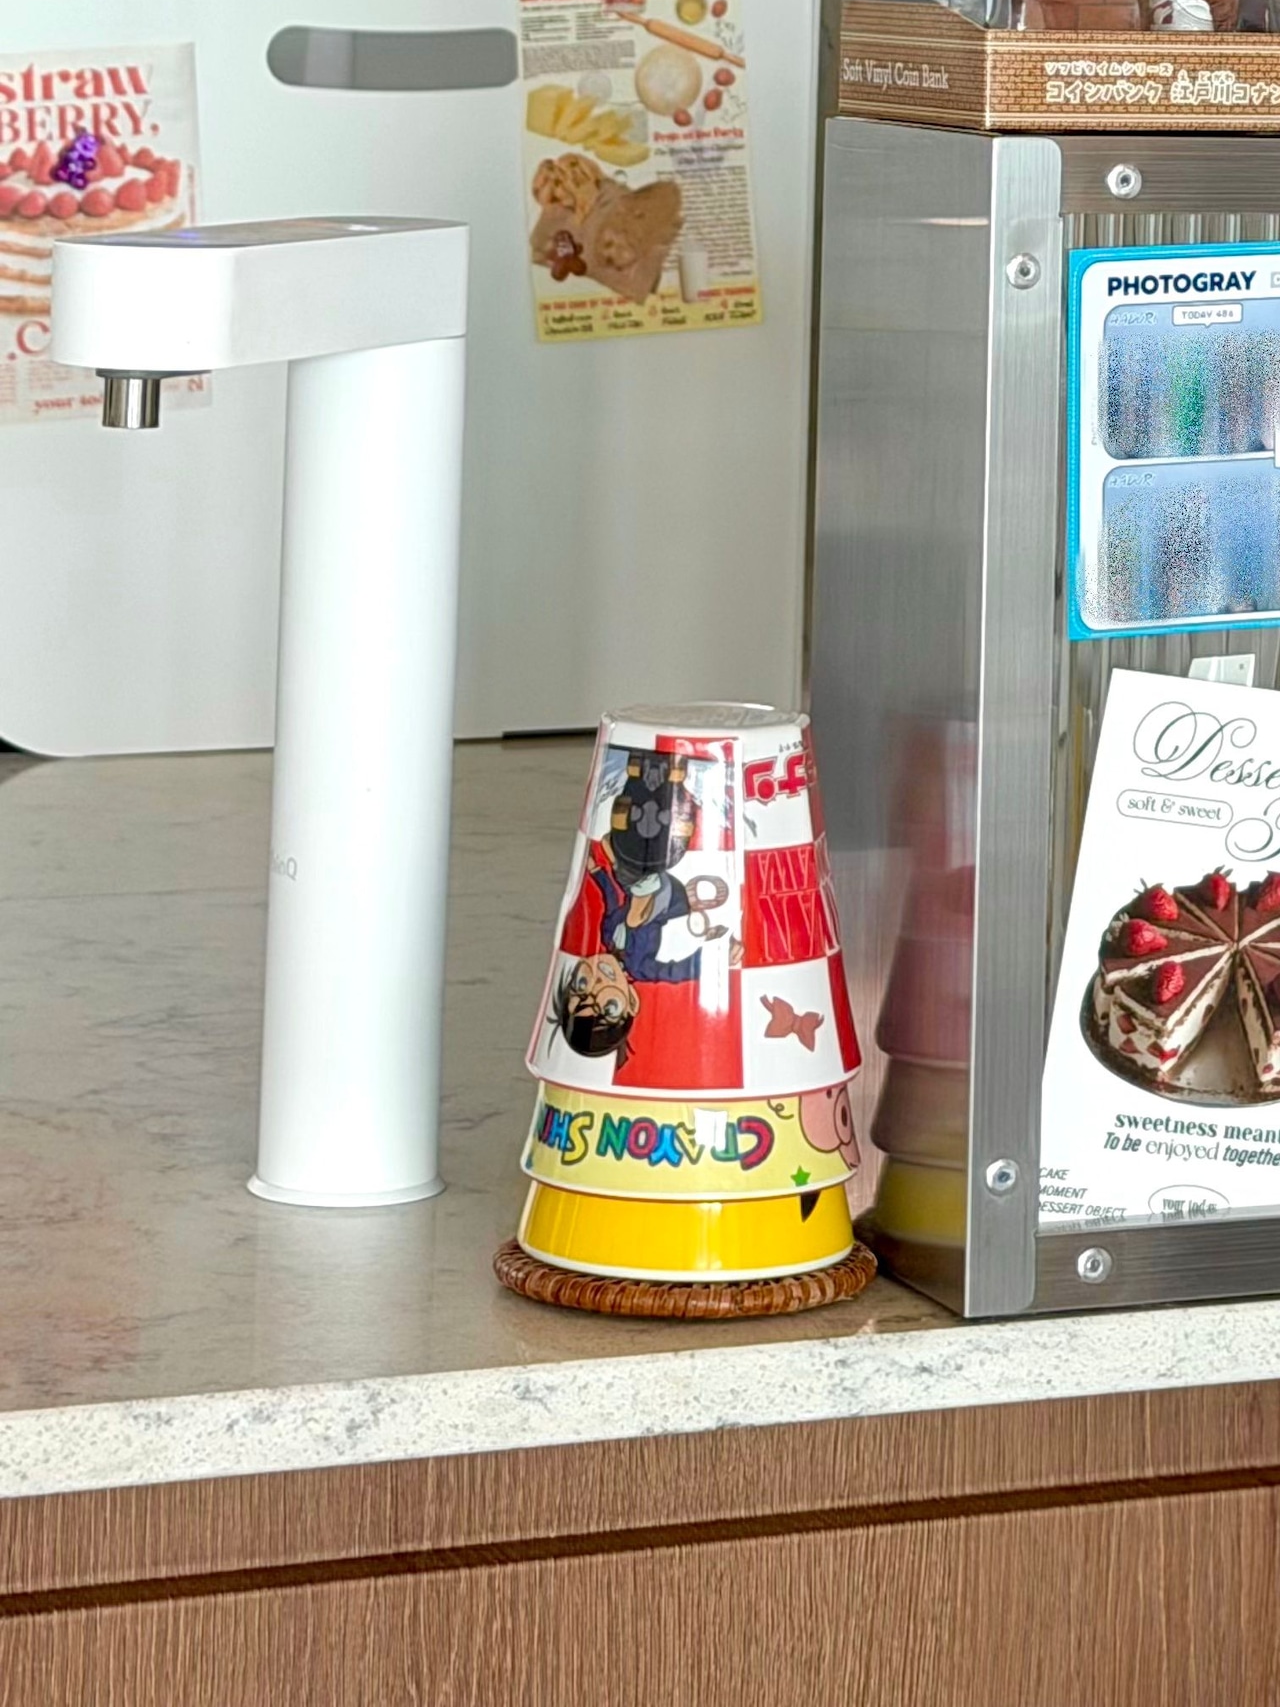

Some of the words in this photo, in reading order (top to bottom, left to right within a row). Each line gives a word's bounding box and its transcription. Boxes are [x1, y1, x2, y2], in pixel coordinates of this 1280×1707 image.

[0, 63, 149, 105] straw
[843, 57, 863, 82] Soft
[865, 59, 892, 92] Vinyl
[894, 62, 920, 87] Coin
[922, 64, 949, 90] Bank
[1046, 80, 1163, 105] コインバンク
[1107, 270, 1257, 297] PHOTOGRAY
[1127, 796, 1156, 812] soft
[1160, 801, 1176, 814] &
[1178, 804, 1222, 821] sweet
[1115, 1113, 1218, 1138] sweetness
[1103, 1131, 1121, 1150] To
[1121, 1133, 1142, 1152] be
[1145, 1138, 1220, 1162] enjoyed
[1039, 1166, 1070, 1180] CAKE
[1085, 1203, 1127, 1218] OBJECT
